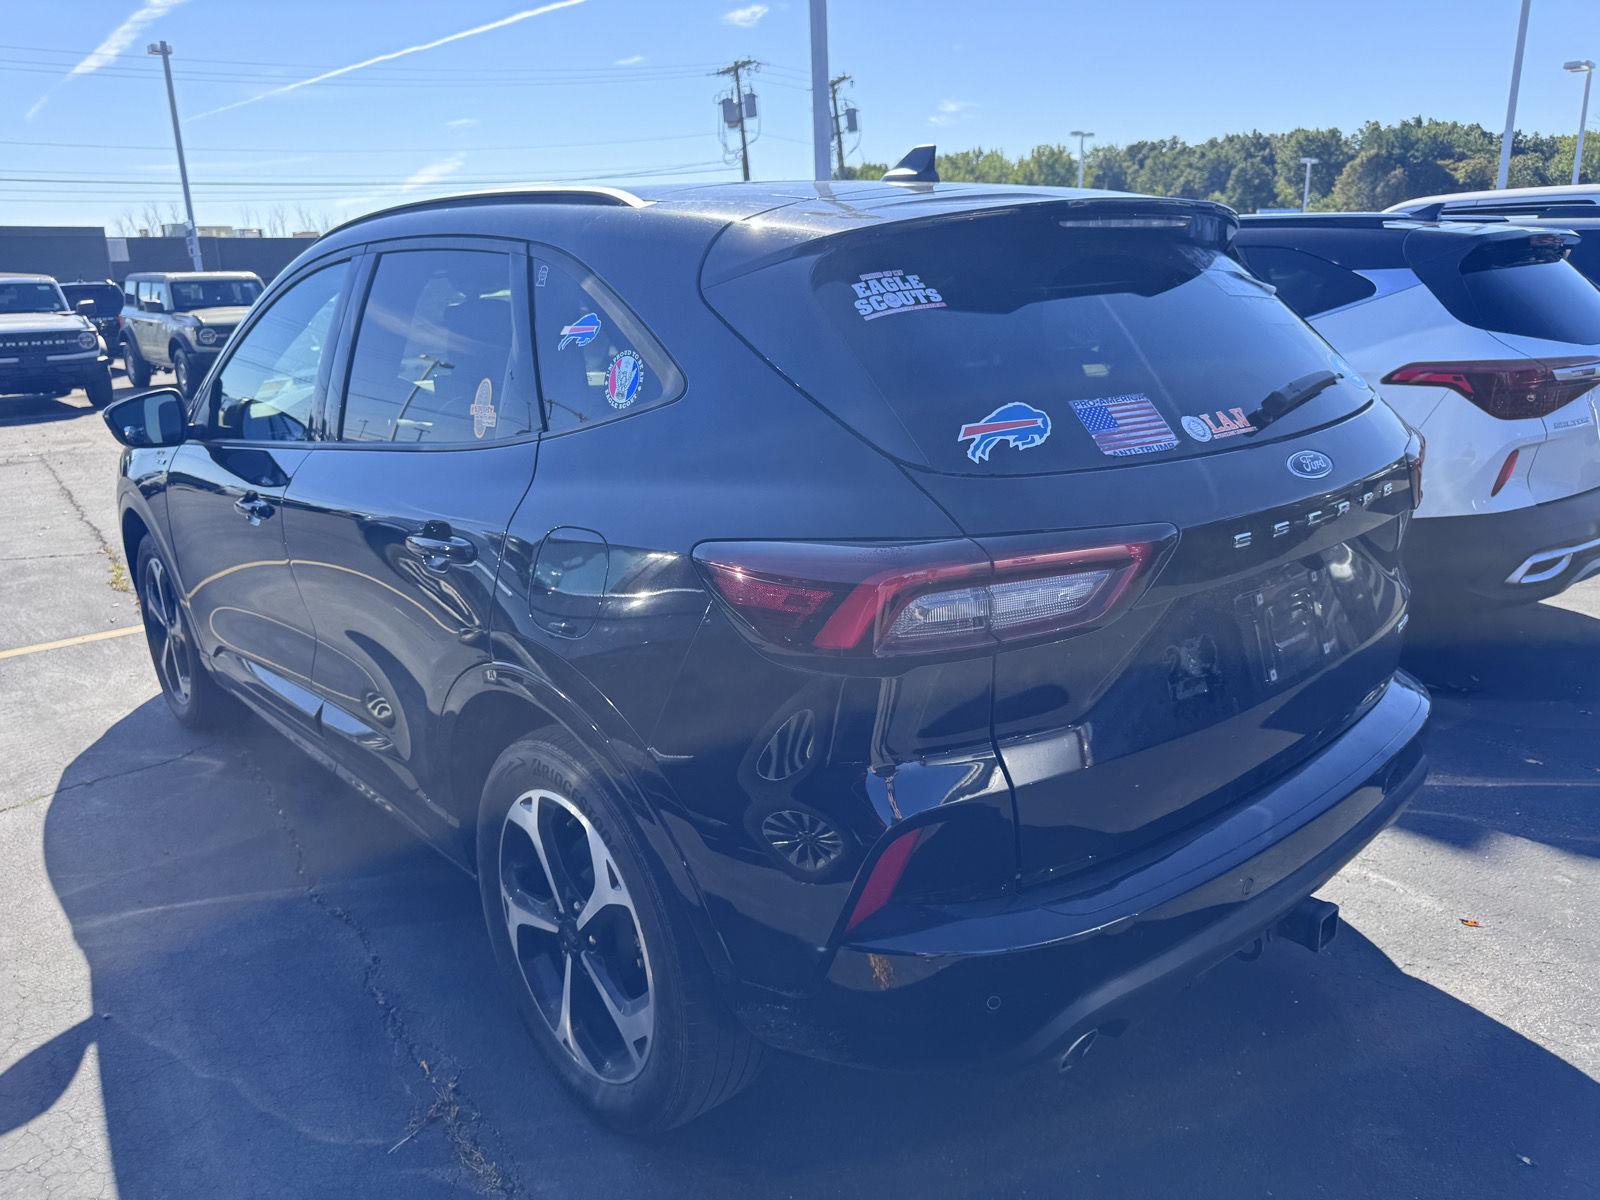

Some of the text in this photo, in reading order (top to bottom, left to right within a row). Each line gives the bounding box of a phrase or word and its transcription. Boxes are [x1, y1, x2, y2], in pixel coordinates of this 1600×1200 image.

[851, 274, 926, 298] EAGLE
[854, 288, 943, 315] SCOUTS
[1107, 440, 1177, 457] ANTI-TRUMP
[1299, 454, 1327, 472] Ford
[1232, 482, 1393, 549] ESCAPE
